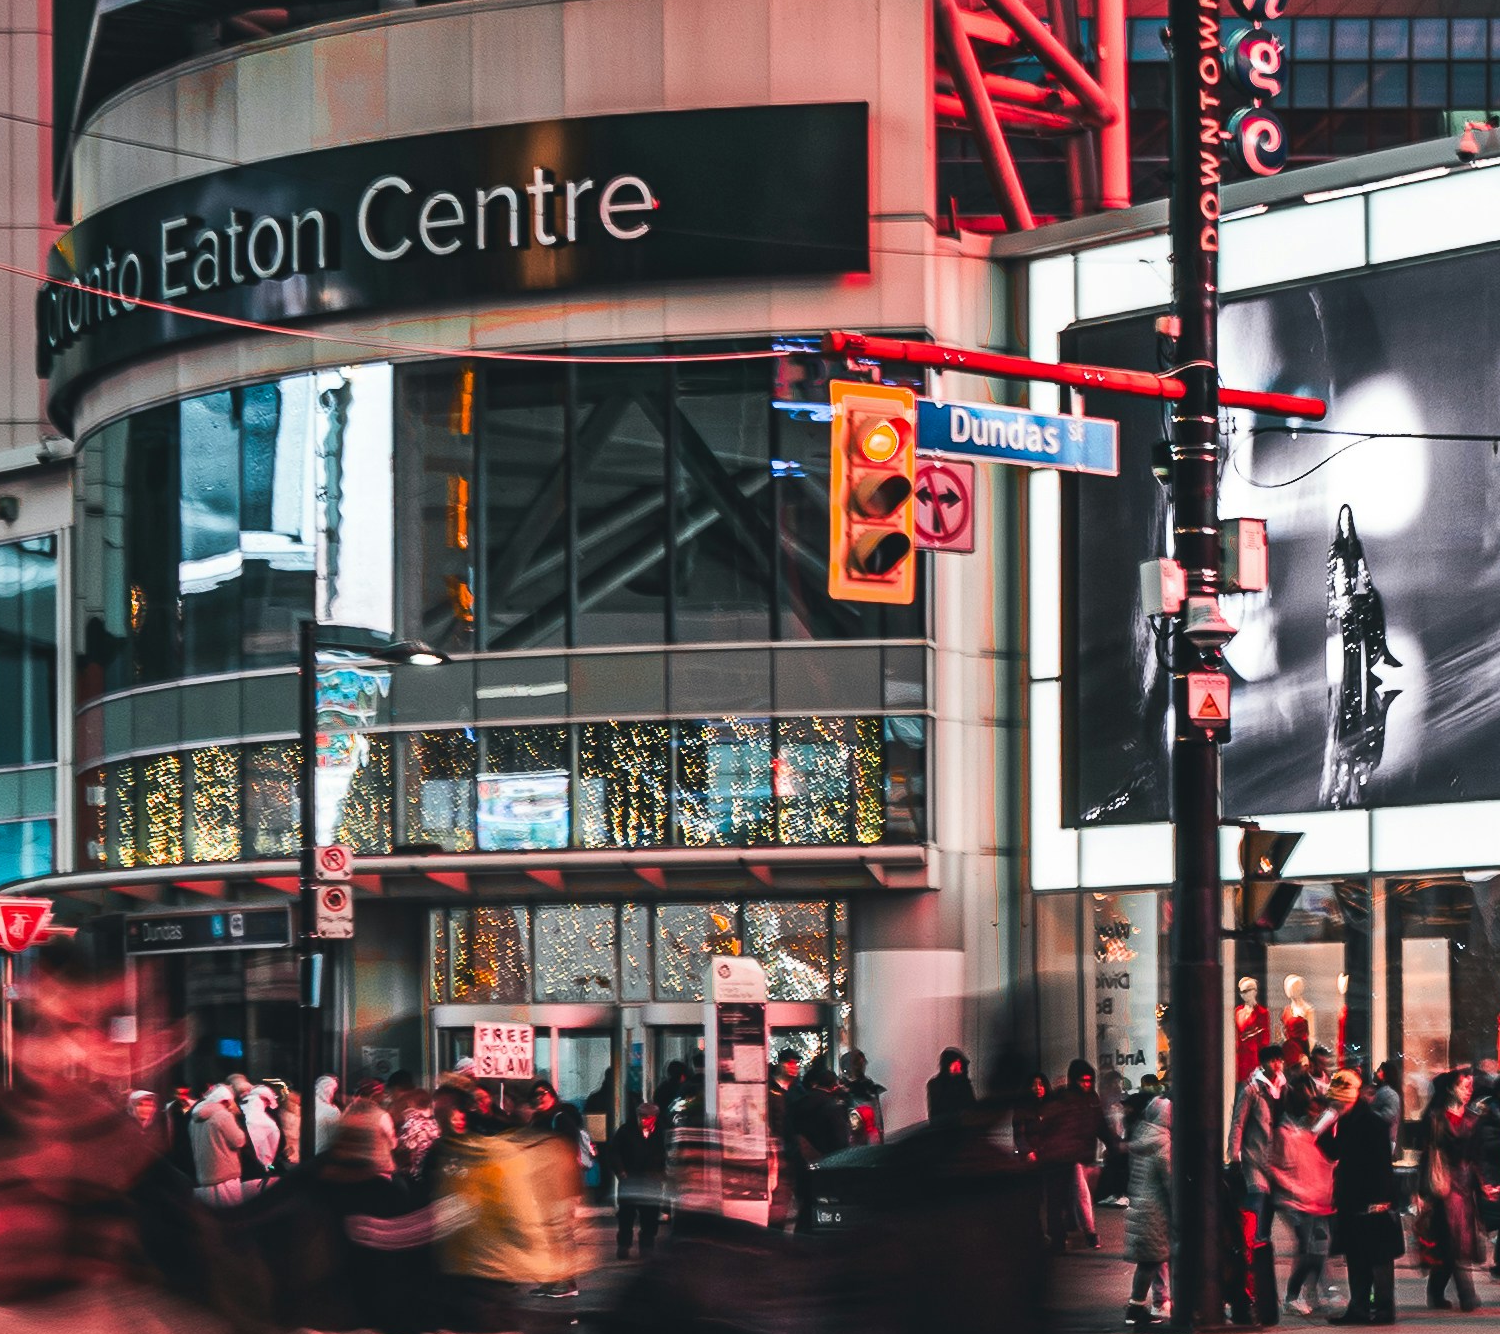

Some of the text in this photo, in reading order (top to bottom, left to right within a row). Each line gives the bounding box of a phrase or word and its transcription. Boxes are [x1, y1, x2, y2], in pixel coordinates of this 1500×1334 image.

[160, 205, 327, 300] Eaton
[358, 165, 659, 261] Centre
[950, 406, 1086, 455] Dundas St
[142, 923, 184, 942] Dundas
[479, 1027, 530, 1043] FREE
[477, 1056, 530, 1076] ISLAM
